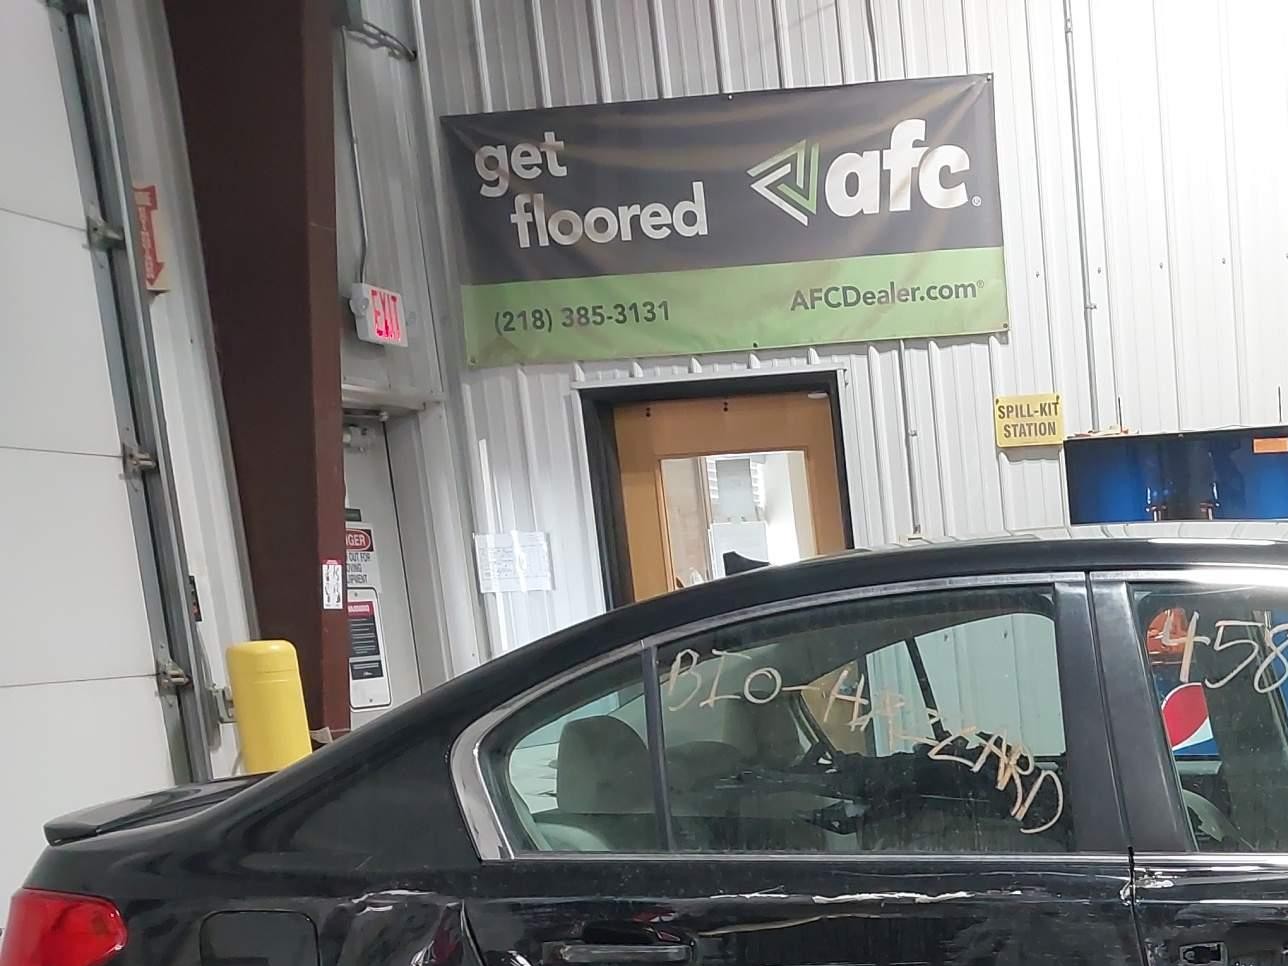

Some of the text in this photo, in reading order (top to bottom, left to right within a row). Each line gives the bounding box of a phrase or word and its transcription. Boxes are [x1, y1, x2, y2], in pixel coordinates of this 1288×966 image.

[475, 131, 567, 197] get
[510, 181, 709, 248] floored
[371, 289, 400, 340] EXIT
[495, 301, 670, 335] (218) 385-3131
[998, 402, 1059, 419] SPILL-KIT
[1003, 422, 1056, 438] STATION
[345, 534, 366, 546] GER
